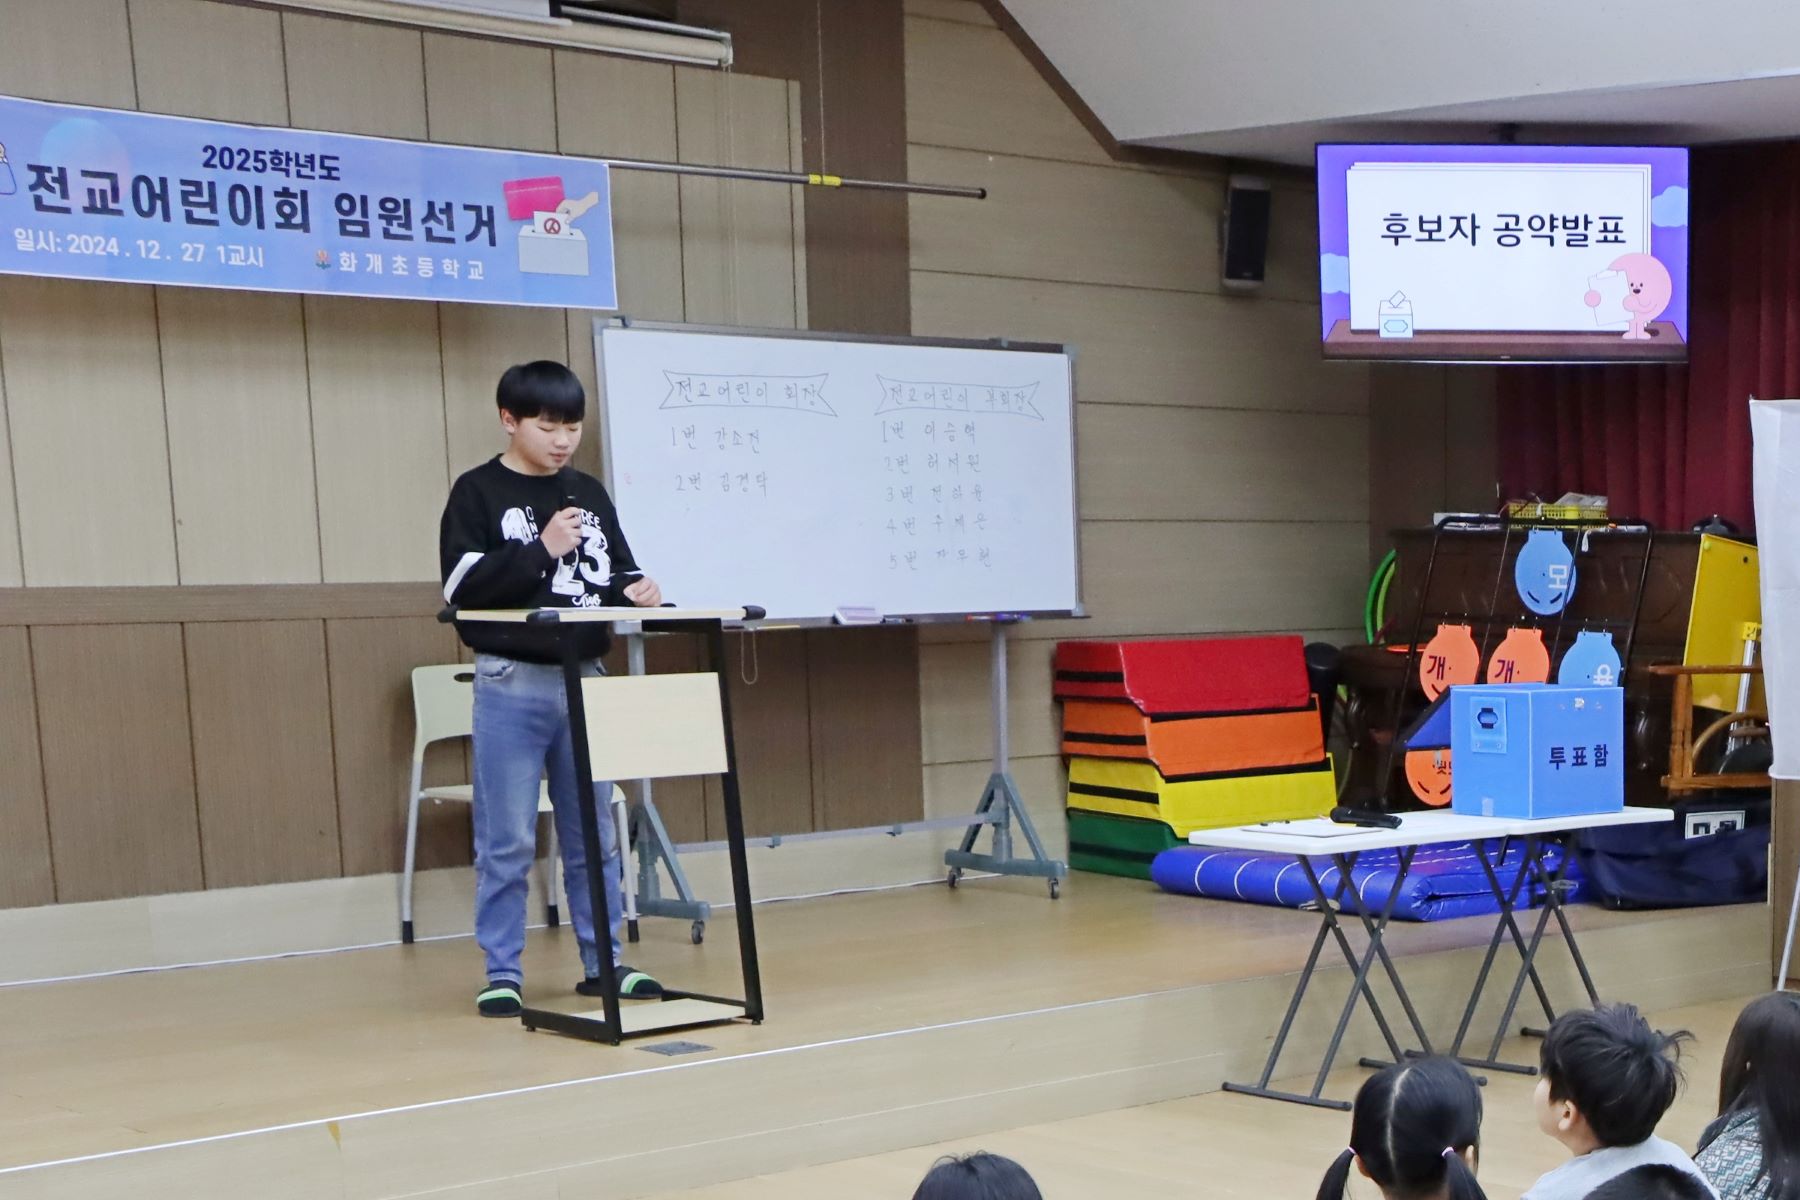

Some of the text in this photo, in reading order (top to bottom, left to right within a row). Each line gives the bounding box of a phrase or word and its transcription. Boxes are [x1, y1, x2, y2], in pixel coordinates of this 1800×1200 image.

[202, 144, 341, 182] 2025학년도
[26, 162, 498, 248] 전교어린이회 임원선거
[1381, 212, 1626, 248] 후보자 공약발표
[14, 228, 62, 254] 일시:
[182, 243, 205, 263] 27
[216, 245, 264, 269] 1교시
[1548, 564, 1569, 589] 모
[1428, 654, 1447, 681] 개
[1494, 658, 1515, 681] 개
[1548, 744, 1609, 771] 투표함
